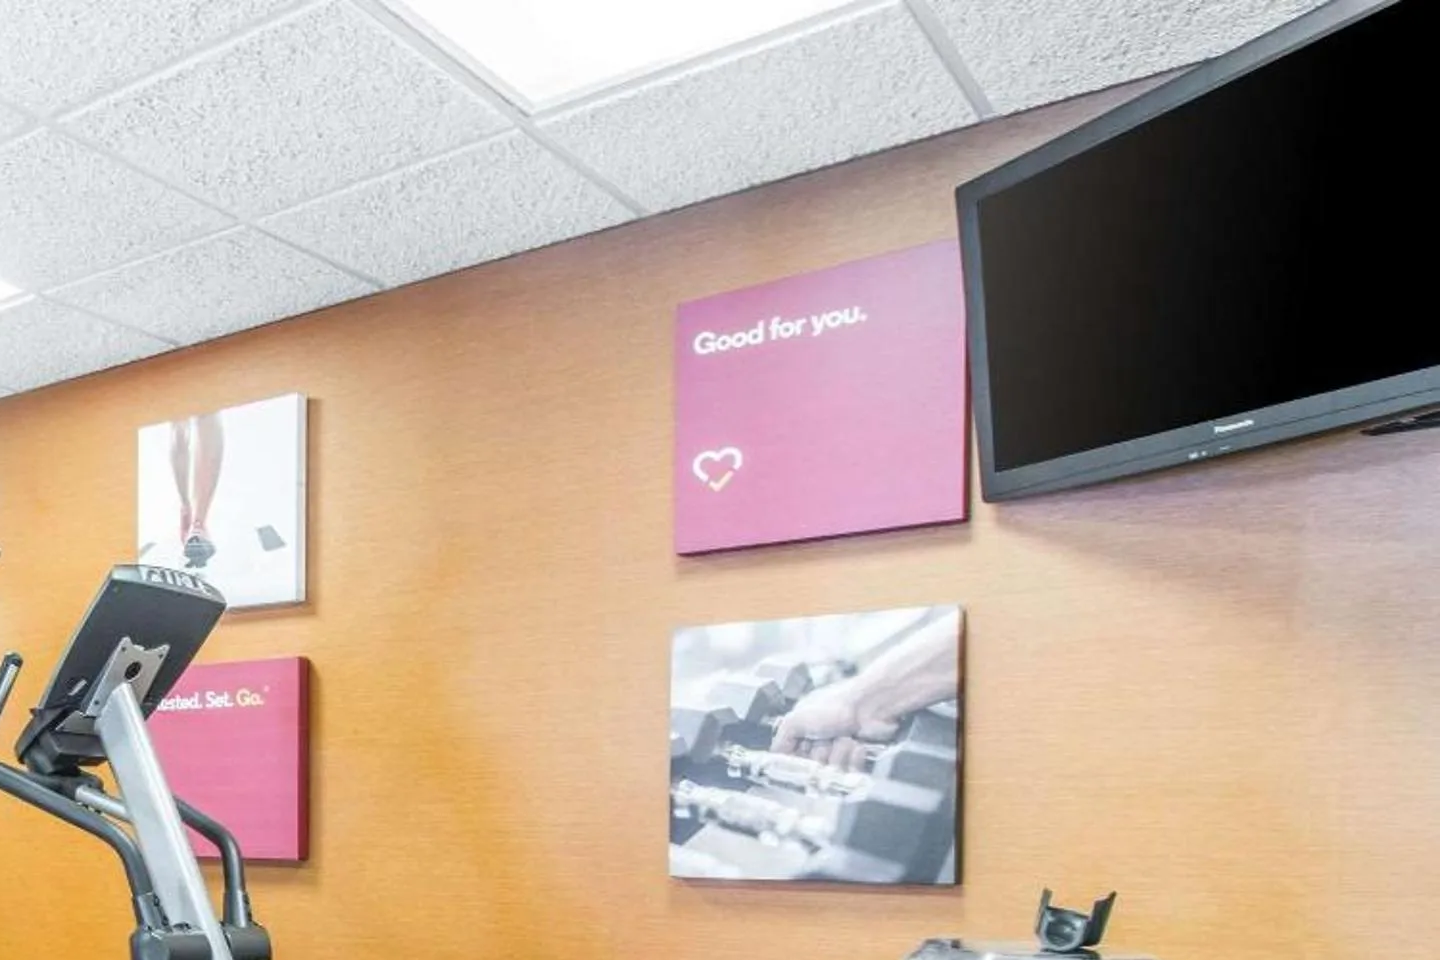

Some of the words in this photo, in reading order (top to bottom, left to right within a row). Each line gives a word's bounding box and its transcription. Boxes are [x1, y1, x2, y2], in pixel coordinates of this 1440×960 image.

[693, 319, 764, 355] Good
[768, 316, 807, 341] for
[810, 306, 868, 337] you.
[157, 692, 203, 711] ested.
[205, 690, 234, 708] Set.
[235, 687, 265, 706] Go.
